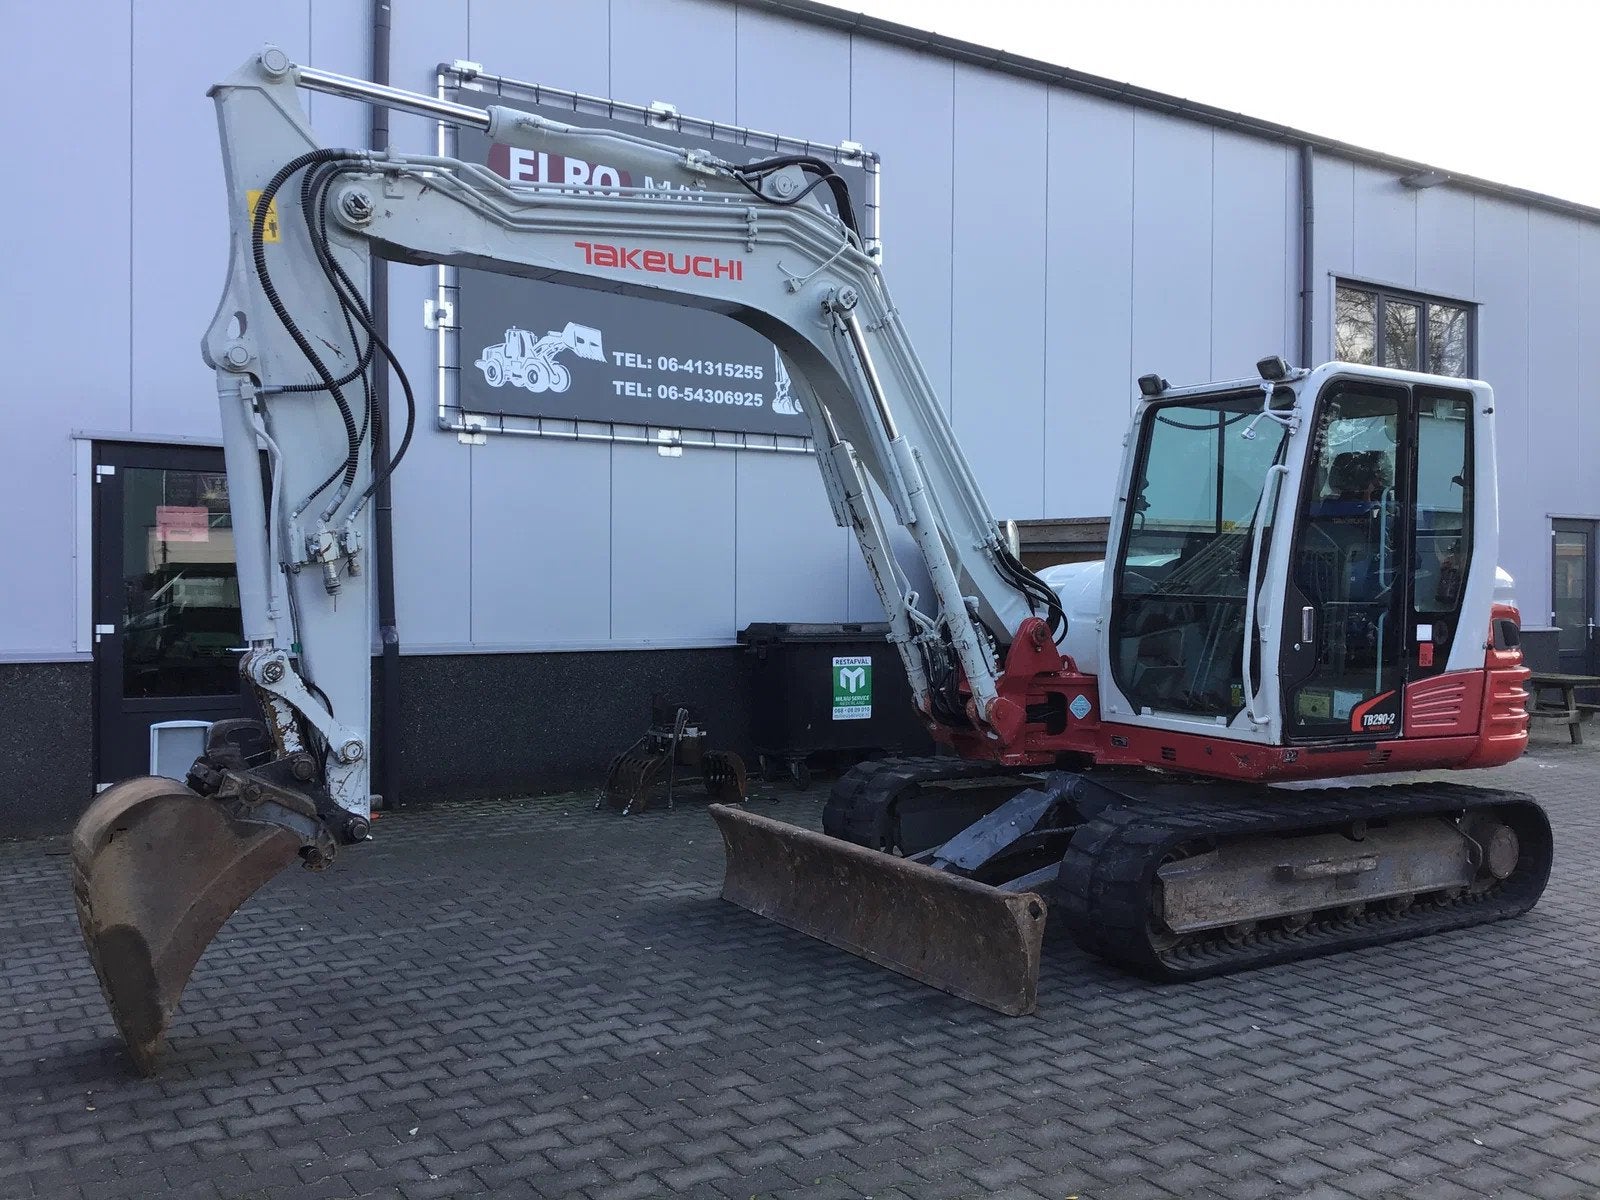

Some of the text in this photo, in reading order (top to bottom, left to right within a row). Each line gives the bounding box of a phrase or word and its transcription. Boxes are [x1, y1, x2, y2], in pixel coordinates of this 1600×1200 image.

[510, 147, 620, 197] ELRO
[575, 241, 742, 281] TAKEUCHI
[612, 351, 763, 380] TEL: 06-41315255
[612, 380, 763, 407] TEL: 06-54306925
[1363, 713, 1395, 726] TB290-2
